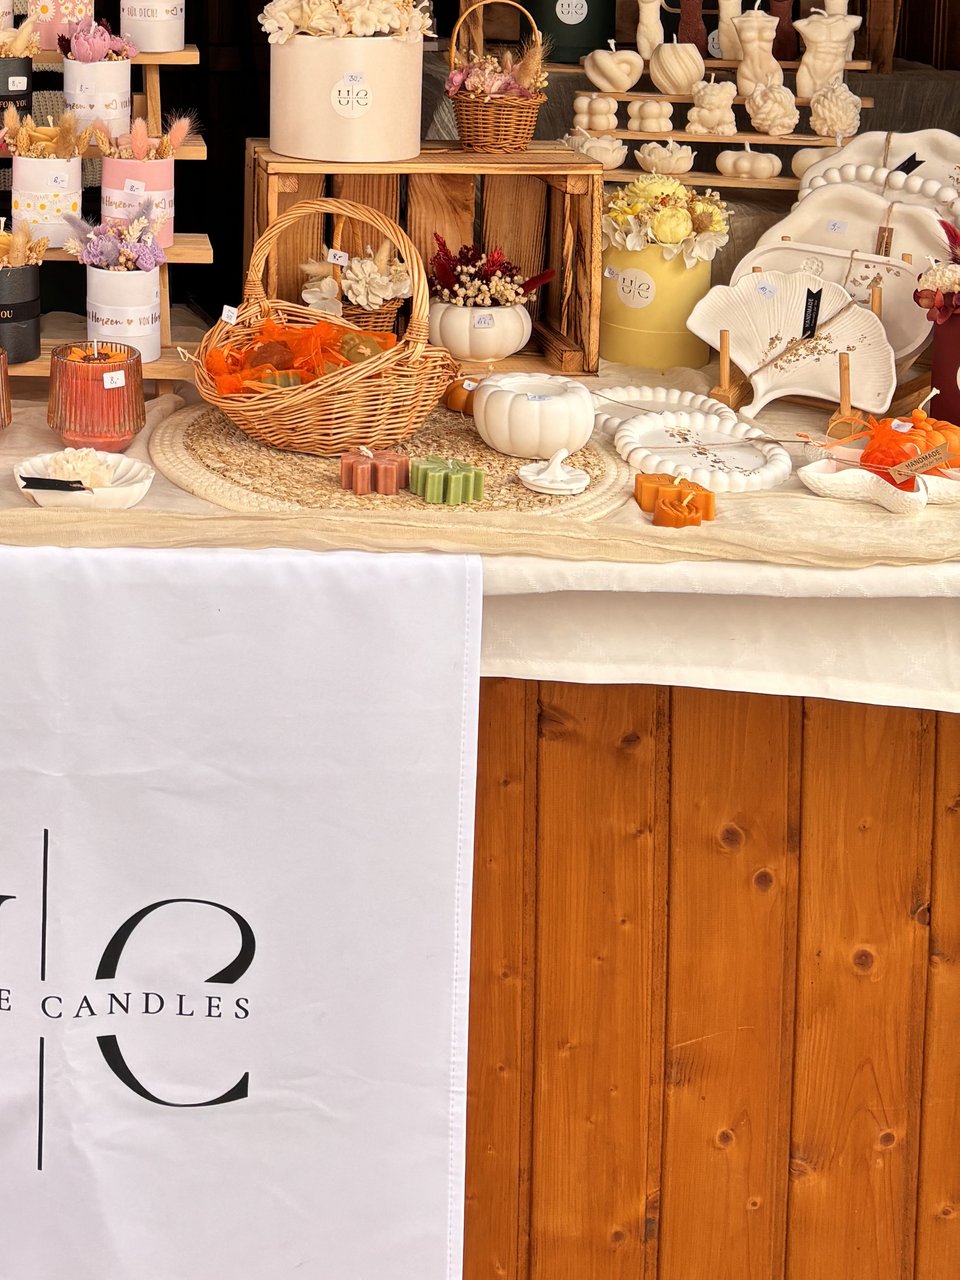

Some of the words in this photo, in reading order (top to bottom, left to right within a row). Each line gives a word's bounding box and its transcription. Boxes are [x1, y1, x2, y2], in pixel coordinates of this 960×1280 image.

[91, 311, 123, 326] Herzen
[905, 449, 942, 470] HANDMADE
[40, 992, 250, 1019] CANDLES
